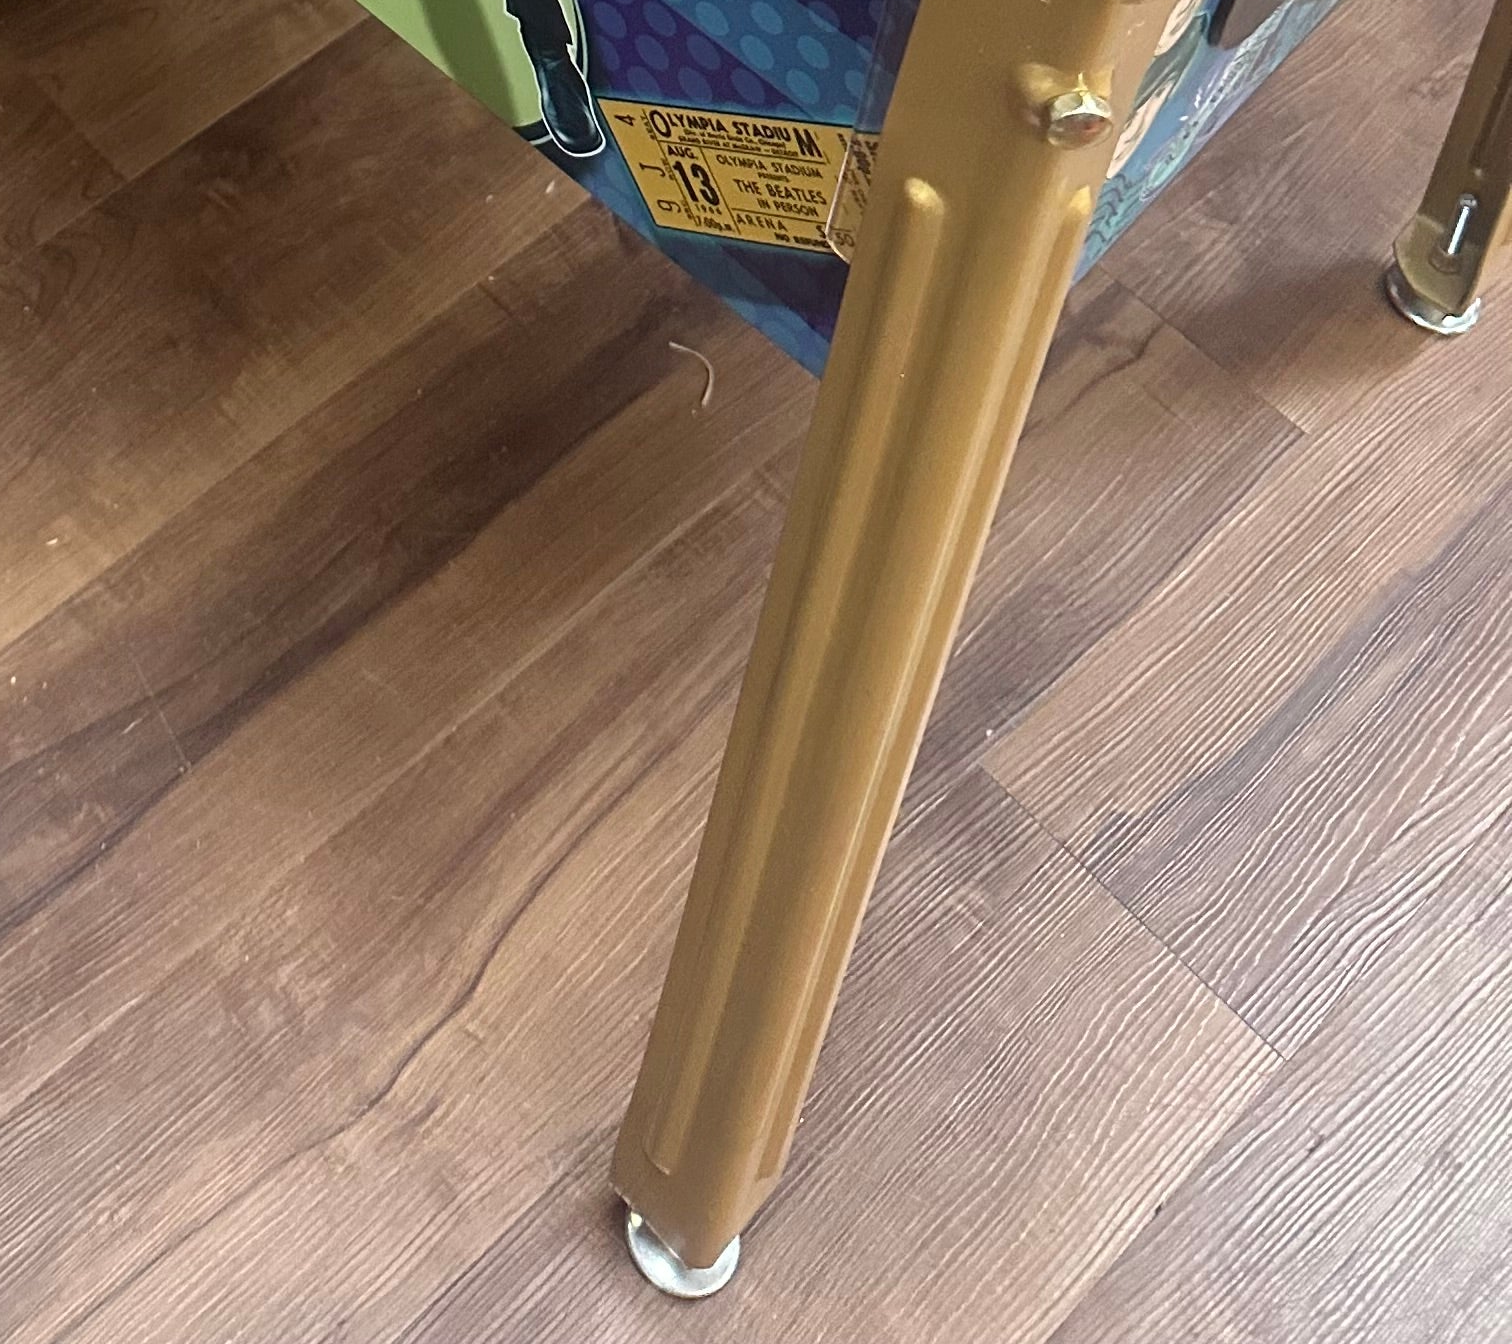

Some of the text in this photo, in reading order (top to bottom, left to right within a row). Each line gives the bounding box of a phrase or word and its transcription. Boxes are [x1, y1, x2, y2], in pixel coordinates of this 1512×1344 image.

[614, 114, 636, 127] 4
[649, 109, 729, 139] OLYMPIA
[732, 121, 823, 158] STADIUM
[667, 145, 699, 160] AUG.
[716, 153, 824, 179] OLYMPIA STADIUM
[672, 160, 720, 207] 13
[733, 178, 827, 205] THE BEATLES
[756, 198, 819, 218] IN PERSON
[736, 213, 789, 232] ARENA
[775, 232, 790, 243] NO
